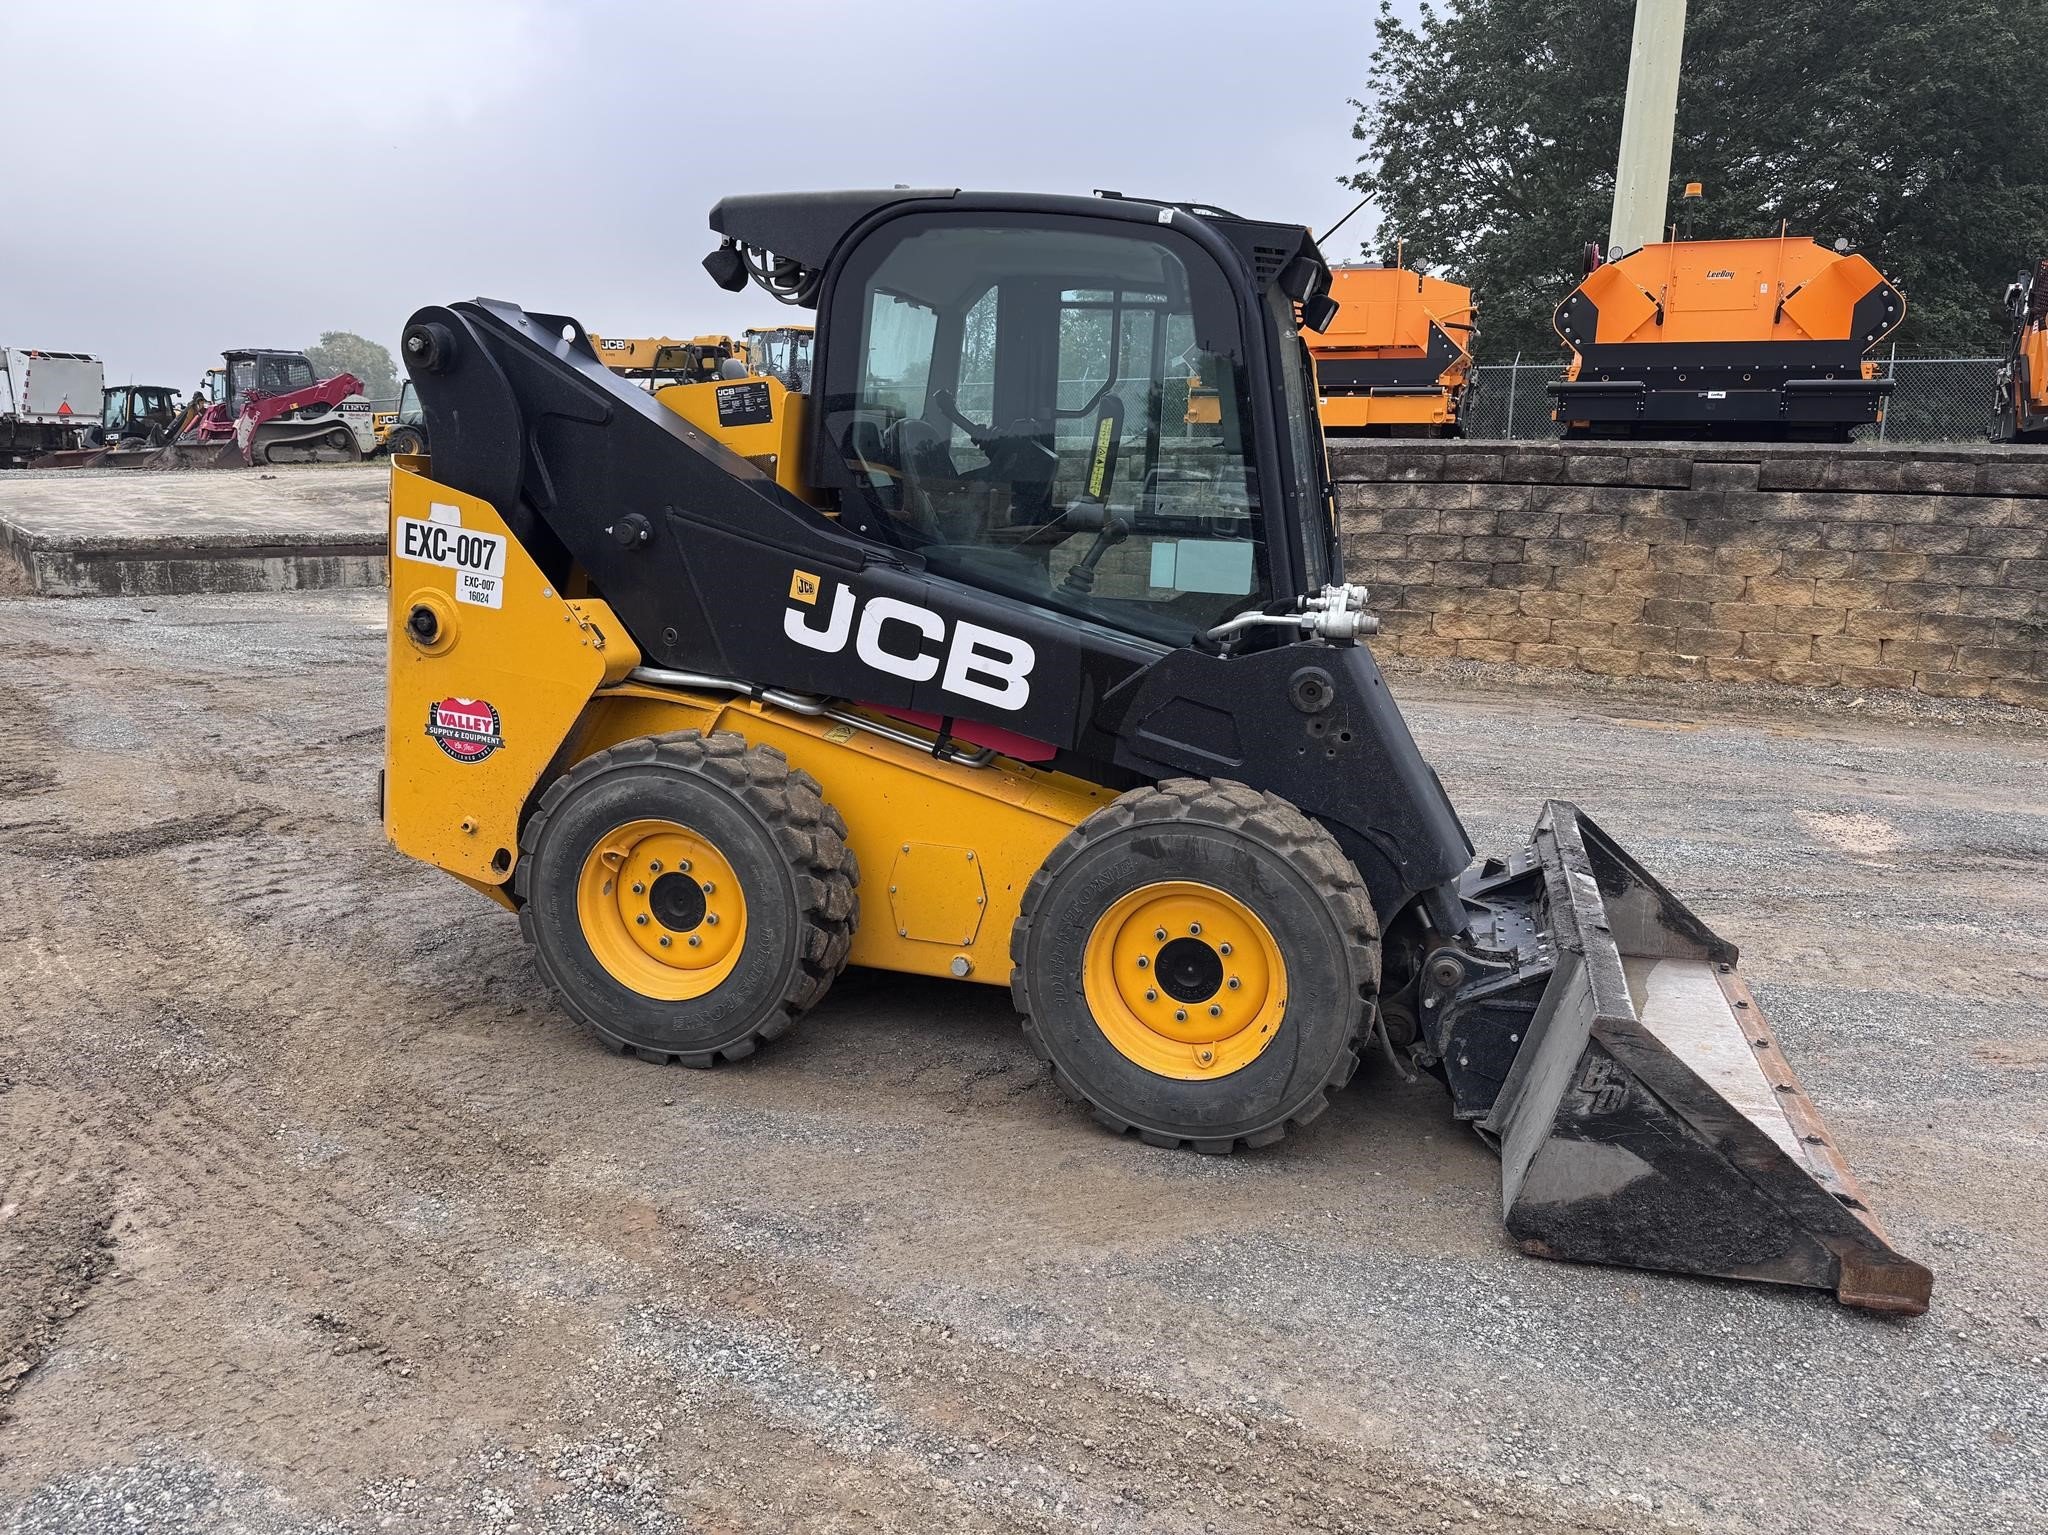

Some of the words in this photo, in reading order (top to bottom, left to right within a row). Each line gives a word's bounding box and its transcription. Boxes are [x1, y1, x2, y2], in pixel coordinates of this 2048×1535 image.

[1706, 270, 1735, 279] LeeBoy
[602, 340, 625, 349] JCB
[404, 522, 497, 571] EXC-007
[464, 575, 496, 591] EXC-007
[798, 578, 815, 594] JCB
[469, 590, 490, 604] 16024
[783, 582, 1036, 711] JCB
[438, 711, 492, 732] VALLEY
[429, 727, 454, 737] SUPPLY
[461, 732, 500, 745] EQUIPMENT
